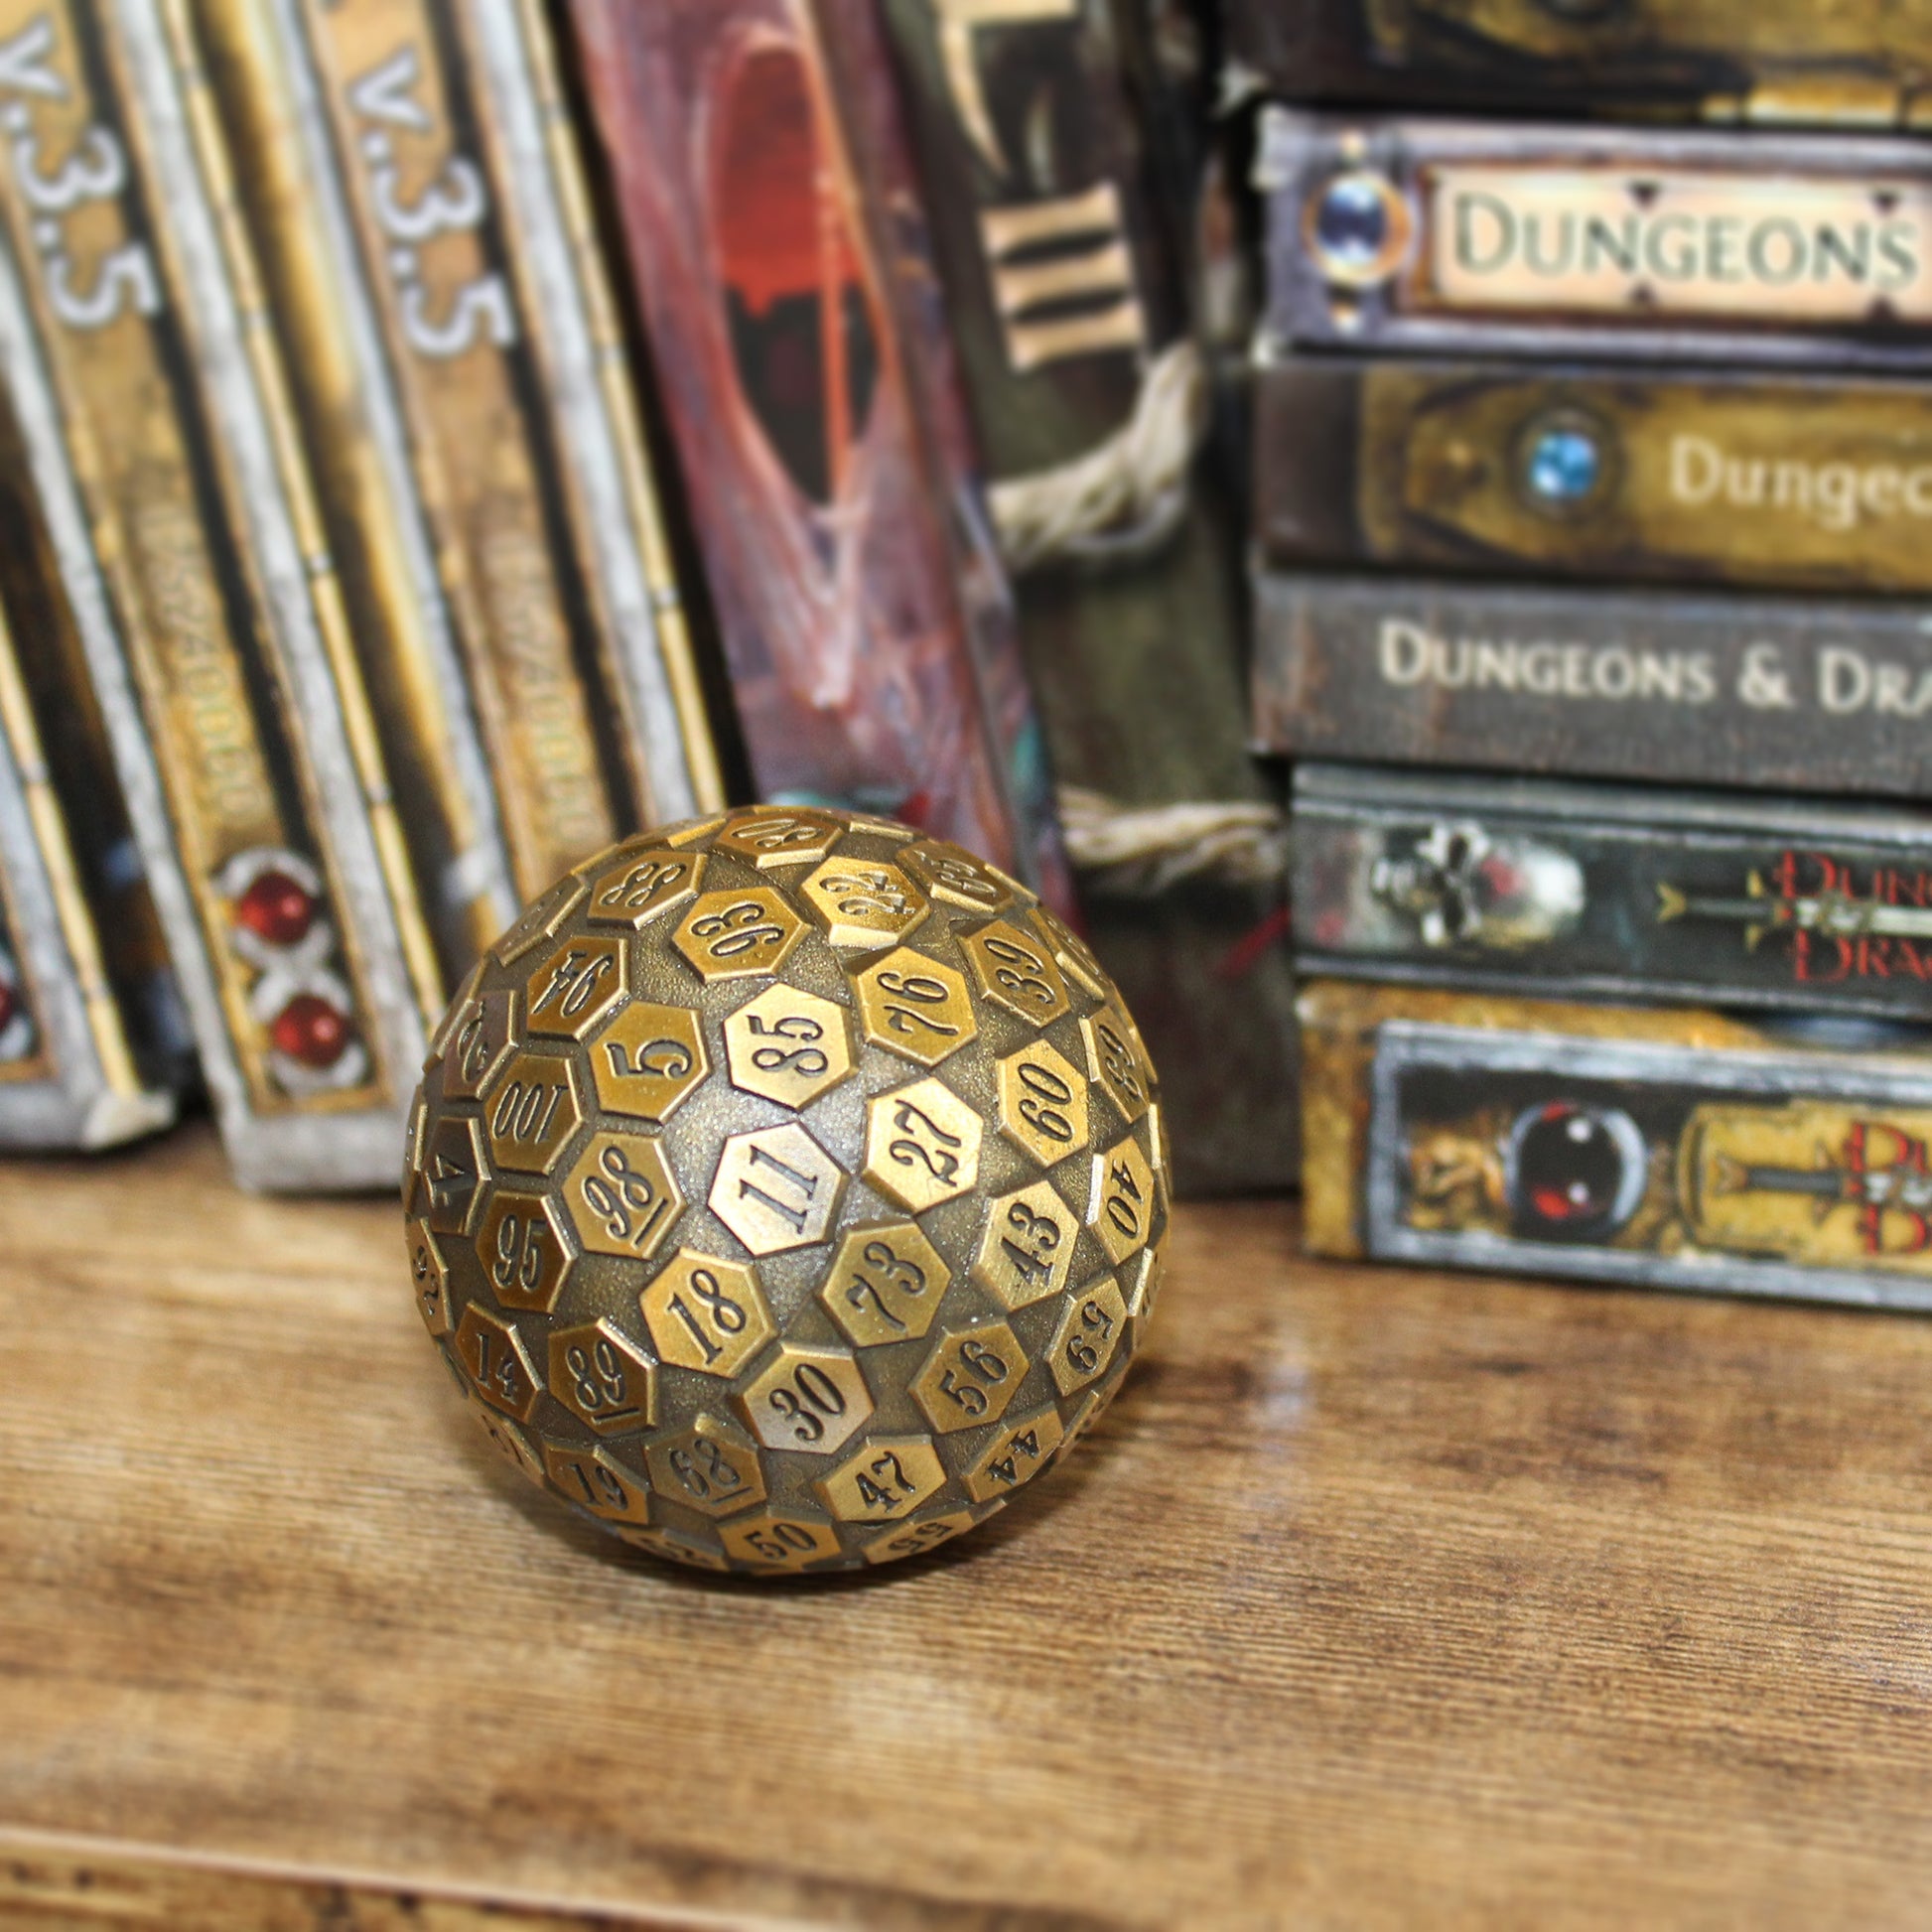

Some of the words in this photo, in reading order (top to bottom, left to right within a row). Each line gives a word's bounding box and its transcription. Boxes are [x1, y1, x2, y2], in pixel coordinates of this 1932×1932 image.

[346, 44, 518, 355] v.3.5
[1453, 191, 1920, 291] DUNGEONS
[1379, 619, 1718, 705] DUNGEONS
[1737, 641, 1794, 711] &
[1773, 849, 1932, 906] DUN
[690, 901, 785, 957] 93
[530, 950, 614, 1019] 94
[878, 969, 960, 1036] 76
[983, 937, 1057, 1005] 39
[604, 1038, 693, 1079] 5
[747, 1015, 829, 1078] 85
[491, 1080, 569, 1146] 100
[1018, 1061, 1074, 1143] 60
[889, 1098, 963, 1188] 27
[580, 1145, 668, 1250] 98
[739, 1144, 819, 1235] 11
[1106, 1159, 1143, 1239] 40
[492, 1213, 548, 1293] 95
[1000, 1201, 1061, 1288] 43
[666, 1268, 748, 1366] 18
[845, 1240, 928, 1333] 73
[476, 1331, 519, 1406] 14
[1065, 1300, 1115, 1373] 59
[565, 1340, 641, 1424] 89
[768, 1362, 847, 1444] 30
[938, 1340, 1011, 1417] 56
[568, 1461, 629, 1512] 19
[668, 1439, 756, 1506] 68
[855, 1449, 916, 1514] 47
[989, 1429, 1041, 1487] 44
[745, 1522, 819, 1561] 50
